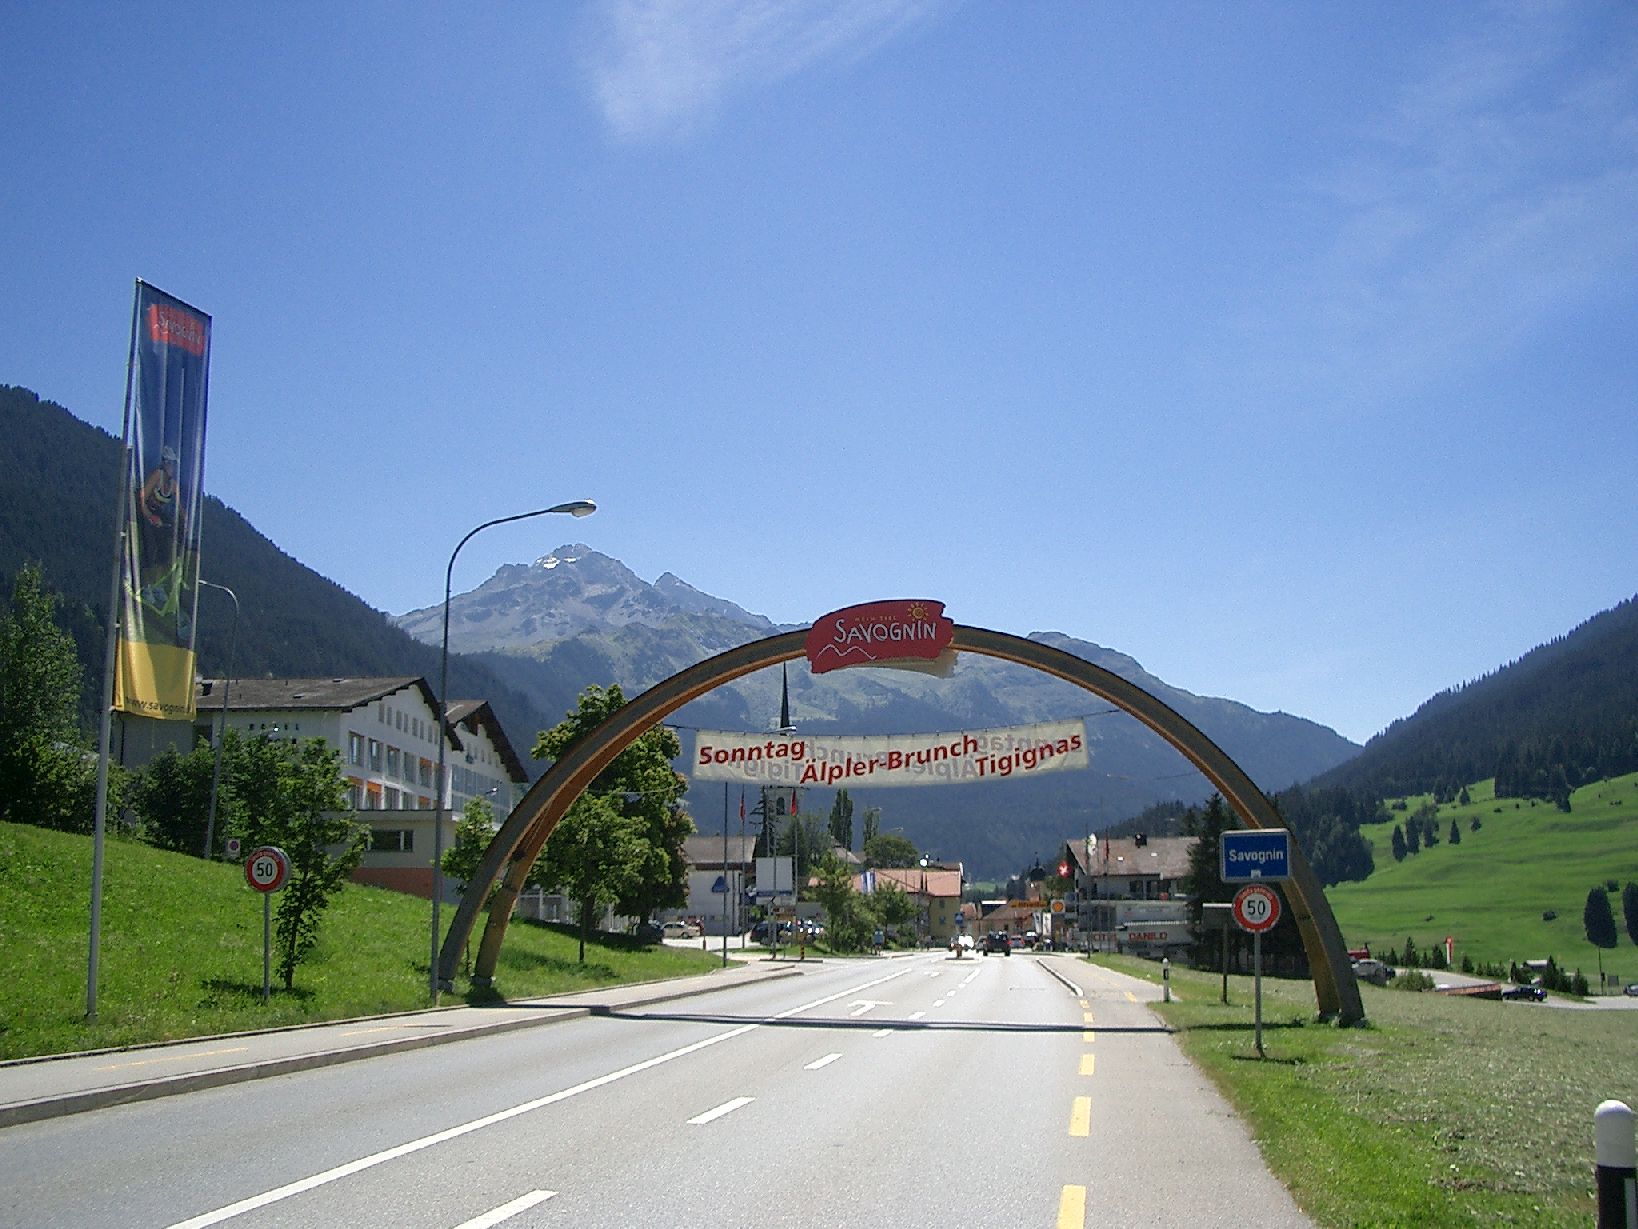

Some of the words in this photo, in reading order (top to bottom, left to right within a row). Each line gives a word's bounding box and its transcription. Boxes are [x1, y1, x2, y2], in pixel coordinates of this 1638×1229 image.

[699, 740, 805, 764] Sonntag
[800, 735, 978, 785] Älpler-Brunch
[975, 735, 1081, 776] Tigignas
[1229, 848, 1284, 864] Savognin
[257, 863, 273, 877] 50
[1247, 900, 1266, 915] 50
